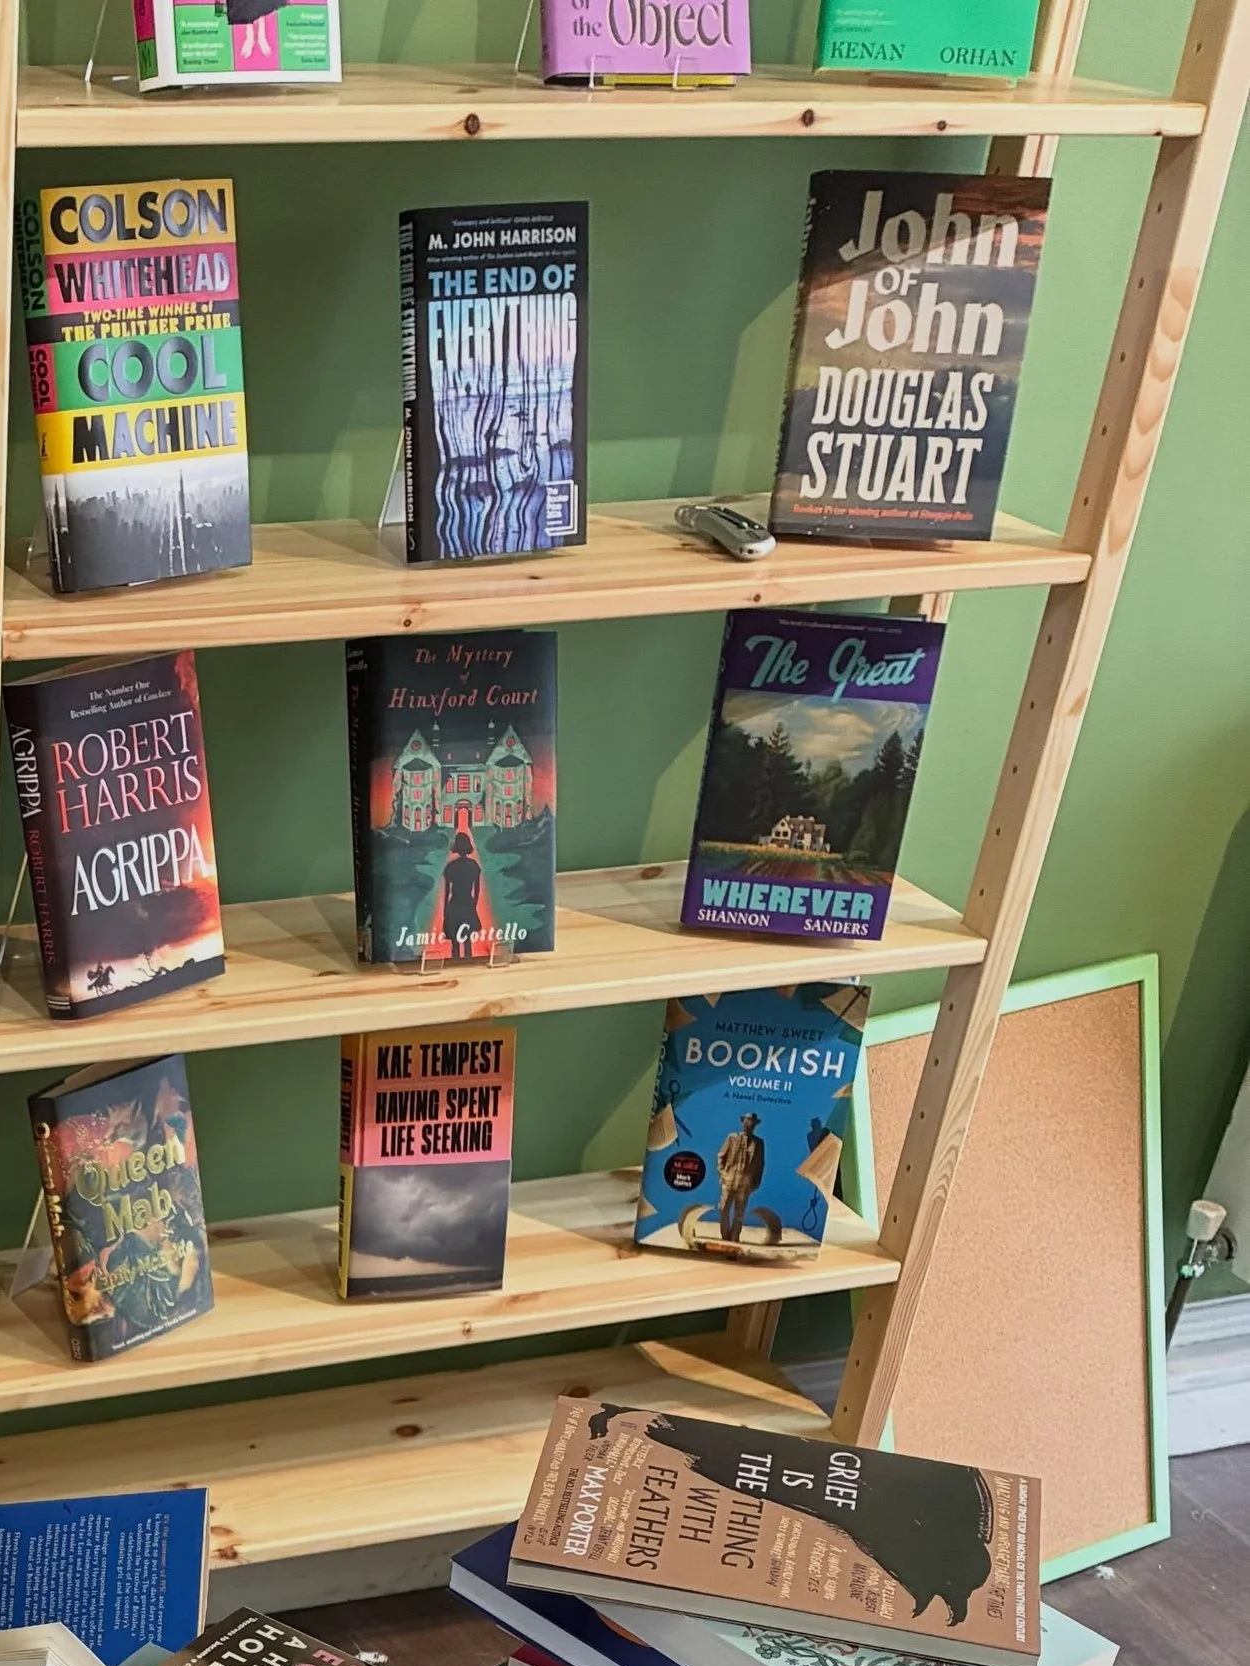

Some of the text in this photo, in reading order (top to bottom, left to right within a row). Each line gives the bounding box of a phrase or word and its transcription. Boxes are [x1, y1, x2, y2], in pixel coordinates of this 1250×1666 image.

[572, 16, 602, 37] the
[608, 0, 733, 57] Object
[830, 41, 1017, 67] KENAN ORHAN
[50, 188, 228, 245] COLSON
[838, 190, 1019, 267] John
[428, 227, 577, 250] M. JOHN HARRISON
[54, 251, 230, 303] WHITEHEAD
[428, 263, 577, 298] THE END OF
[874, 266, 923, 296] OF
[62, 312, 231, 343] THE PULITZER PRIZE
[83, 301, 214, 324] TWO-TIME WINNER of
[428, 292, 577, 369] EVERYTHING
[825, 280, 1004, 357] John
[77, 334, 228, 402] COOL
[811, 366, 994, 432] DOUGLAS
[72, 400, 239, 465] MACHINE
[799, 431, 984, 505] STUART
[414, 645, 513, 669] The Mystery
[459, 671, 471, 685] of
[745, 635, 926, 703] The Great
[388, 684, 539, 717] Hinxford Court
[51, 711, 195, 785] ROBERT
[55, 754, 203, 834] HARRIS
[70, 823, 213, 917] AGRIPPA
[702, 878, 875, 920] WHEREVER
[396, 922, 528, 948] Jamie Costello
[697, 908, 869, 936] SHANNON SANDERS
[715, 1021, 826, 1042] MATTHEW SWEET
[377, 1040, 504, 1080] KAE TEMPEST
[685, 1037, 846, 1079] BOOKISH
[729, 1074, 792, 1092] VOLUME II
[375, 1086, 502, 1124] HAVING SPENT
[380, 1120, 492, 1158] LIFE SEEKING
[75, 1132, 188, 1207] Queen
[103, 1181, 176, 1243] Mab
[735, 1453, 773, 1494] THE
[781, 1469, 815, 1490] IS
[824, 1451, 862, 1511] GRIEF
[563, 1464, 609, 1556] MAX PORTER
[625, 1464, 679, 1571] FEATHERS
[679, 1486, 721, 1544] WITH
[720, 1498, 764, 1570] THING
[282, 1636, 308, 1651] A
